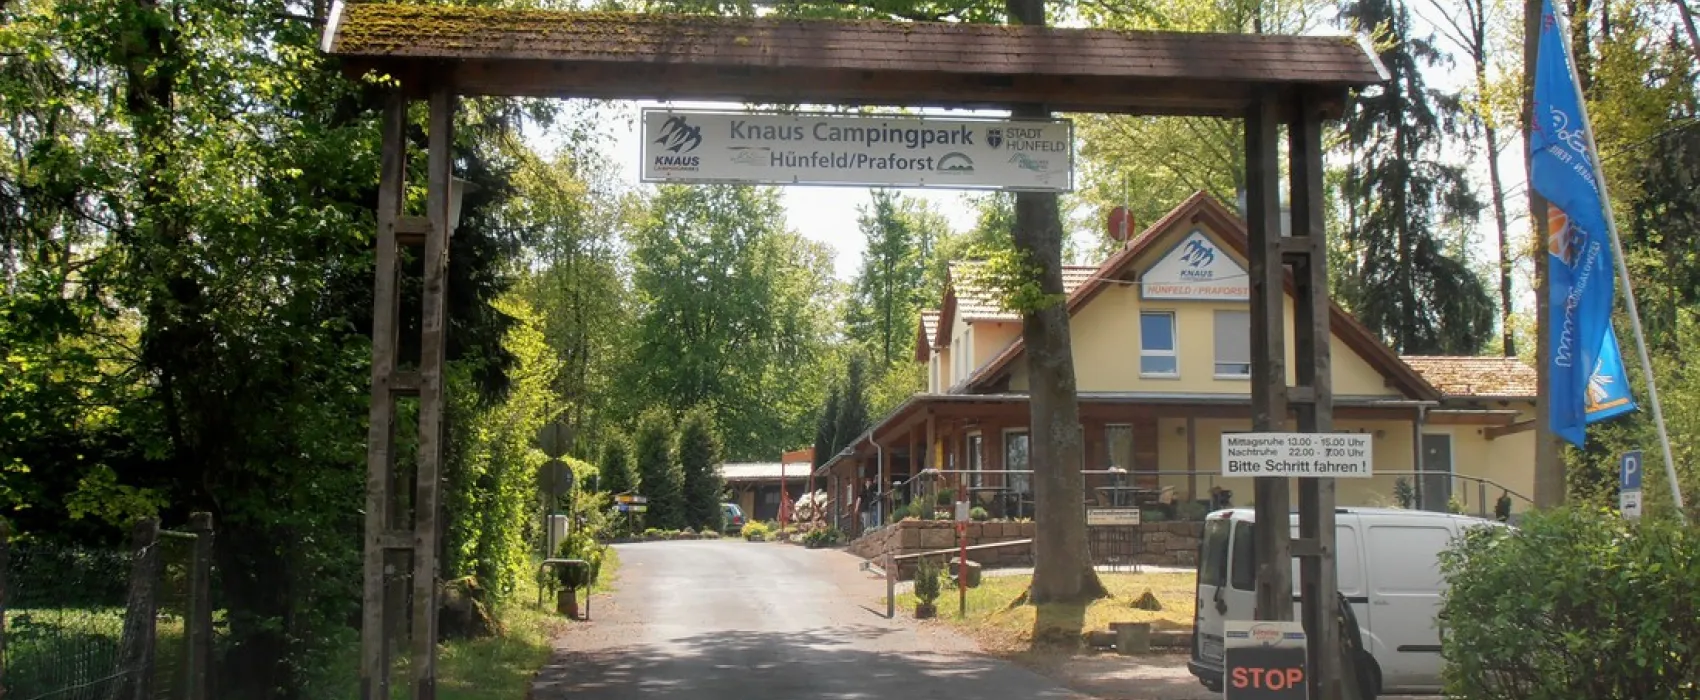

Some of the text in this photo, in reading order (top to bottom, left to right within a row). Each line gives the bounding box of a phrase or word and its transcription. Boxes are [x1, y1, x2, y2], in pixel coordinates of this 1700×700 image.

[730, 120, 974, 149] Knaus Campingpark
[1006, 128, 1042, 138] STADT
[654, 156, 700, 166] KNAUS
[770, 151, 934, 171] Hünfeld/Praforst
[1199, 285, 1249, 295] PRAFORST
[1228, 437, 1284, 447] Mittagsruhe
[1287, 437, 1311, 446] 13.00
[1321, 438, 1344, 447] 15.00
[1348, 437, 1365, 447] Uhr
[1228, 449, 1278, 457] Nachtruhe
[1288, 448, 1314, 457] 22.00
[1348, 448, 1364, 457] Uhr
[1229, 460, 1260, 473] Bitte
[1265, 459, 1310, 473] Schritt
[1314, 460, 1358, 473] fahren
[1625, 457, 1637, 485] P
[1232, 667, 1303, 690] STOP
